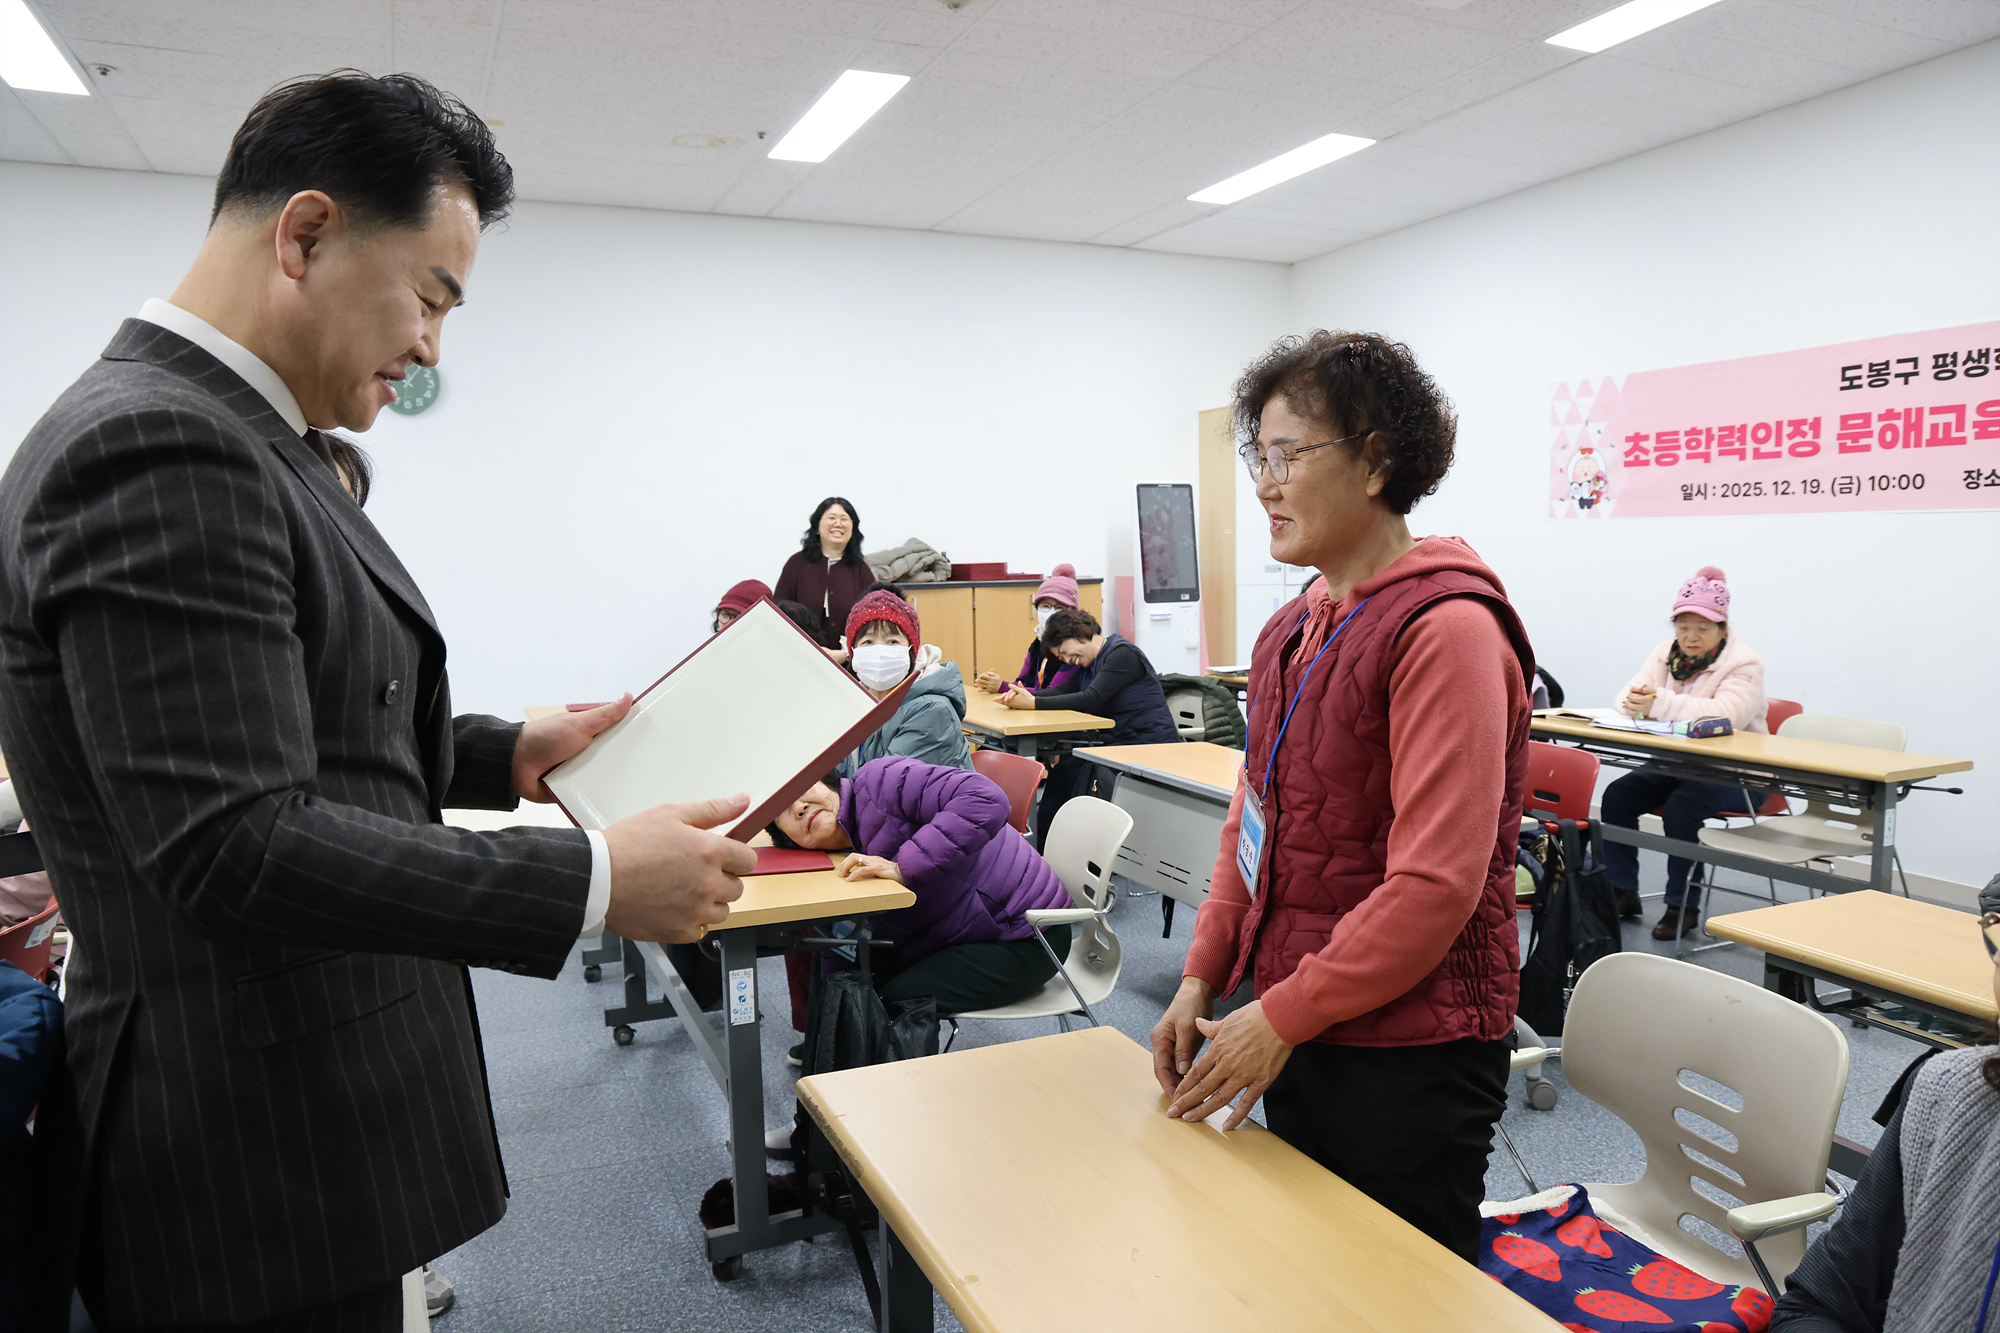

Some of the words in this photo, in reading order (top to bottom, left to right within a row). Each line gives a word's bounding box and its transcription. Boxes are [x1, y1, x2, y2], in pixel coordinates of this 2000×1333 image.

[424, 370, 432, 378] 2
[1839, 356, 1919, 391] 도봉구
[427, 380, 434, 388] 3
[423, 390, 431, 398] 4
[404, 400, 412, 409] 6
[416, 398, 423, 406] 5
[1623, 416, 1822, 468] 초등학력인정
[1680, 482, 1708, 501] 일시
[1721, 481, 1767, 498] 2025.
[1772, 479, 1795, 496] 12.
[1800, 478, 1825, 495] 19.
[1831, 475, 1862, 497] (금)
[1868, 473, 1926, 492] 10:00
